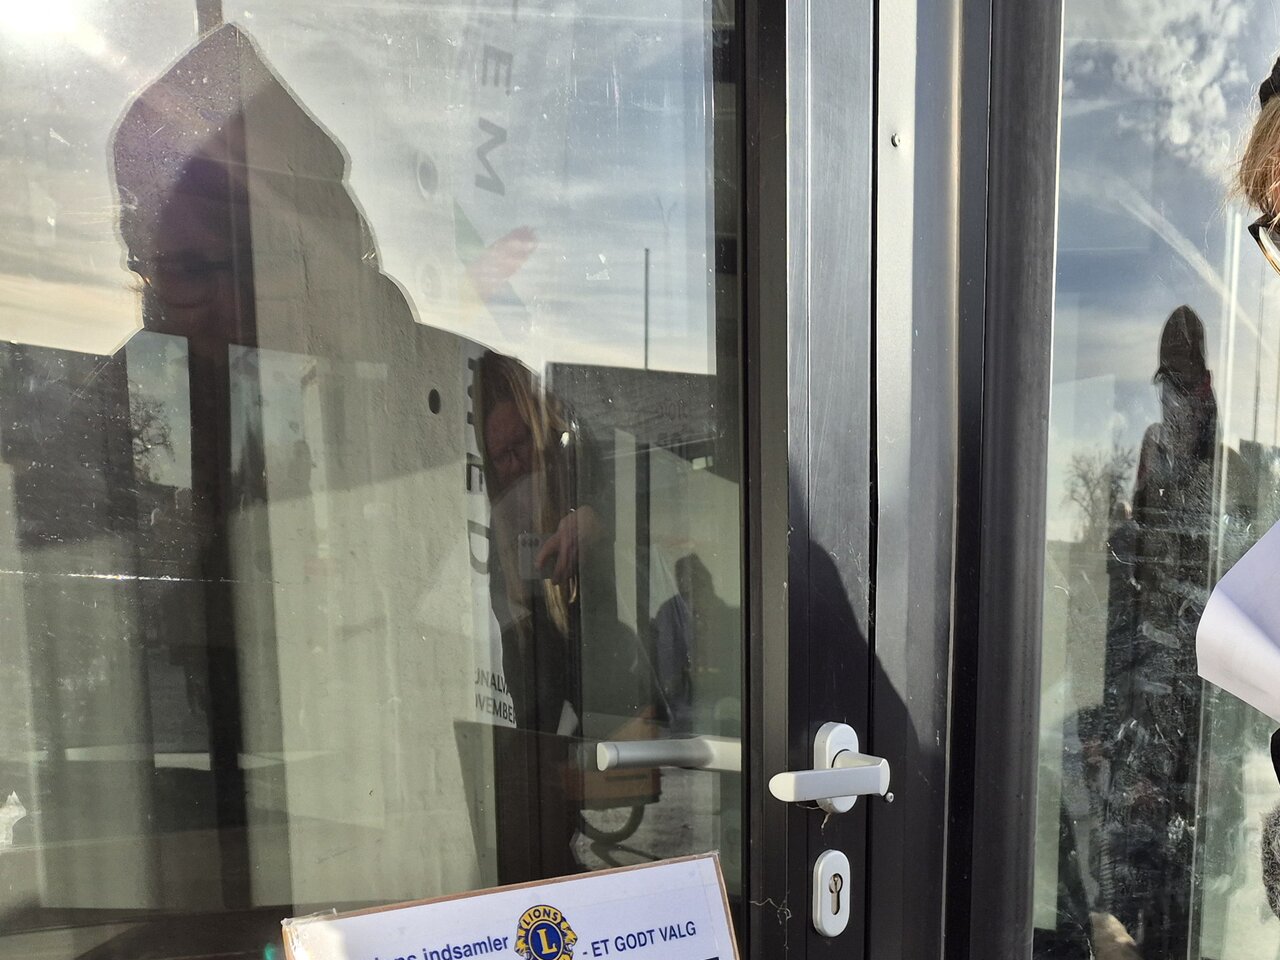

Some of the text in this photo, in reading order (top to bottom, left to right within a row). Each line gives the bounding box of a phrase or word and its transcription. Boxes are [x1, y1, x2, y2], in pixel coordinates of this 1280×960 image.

[523, 908, 559, 927] LIONS
[537, 929, 558, 954] L
[591, 939, 611, 957] ET
[614, 929, 656, 952] GODT
[658, 921, 697, 942] VALG
